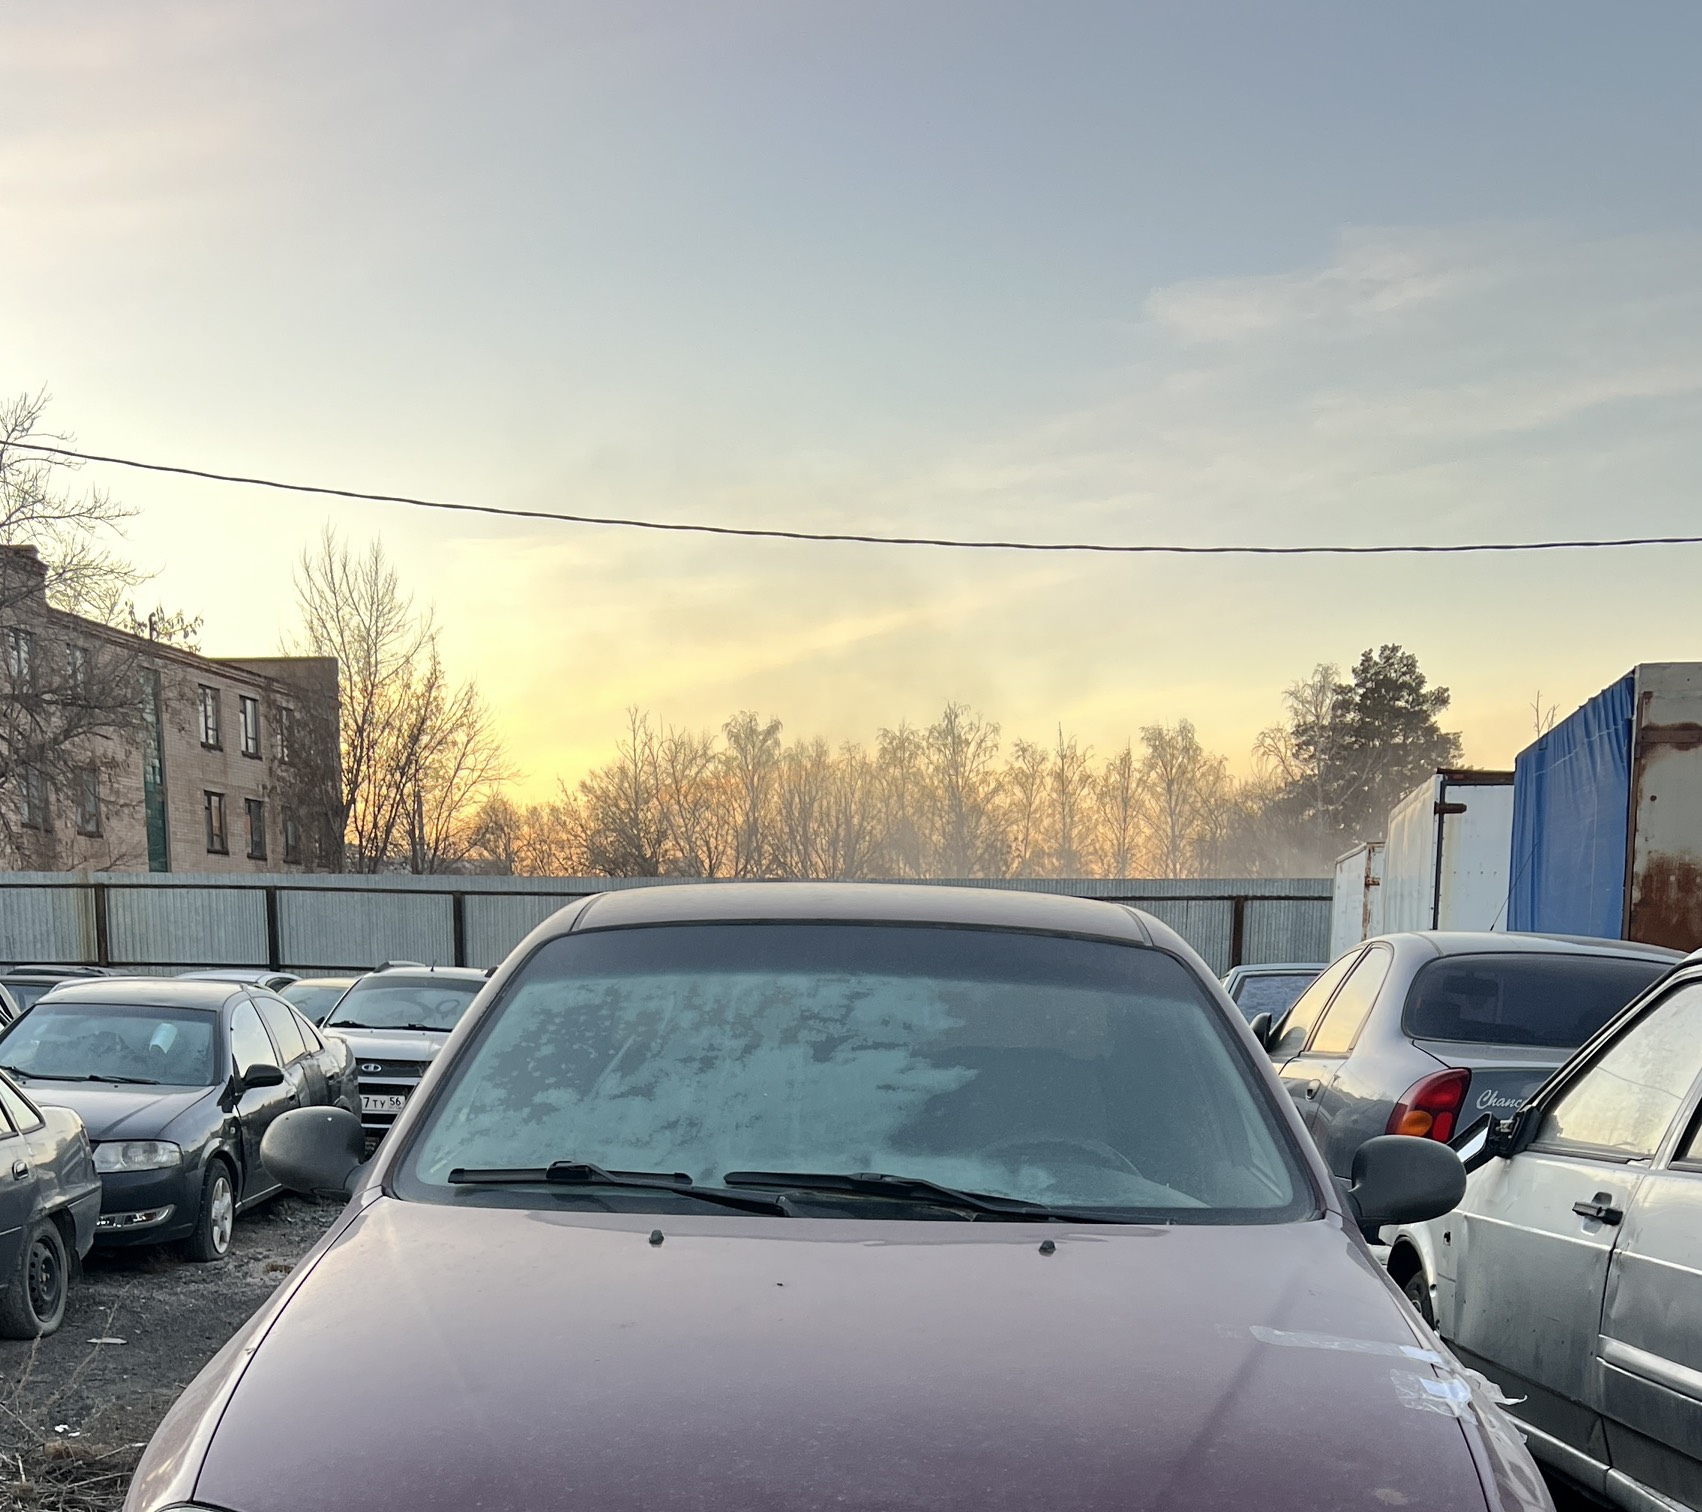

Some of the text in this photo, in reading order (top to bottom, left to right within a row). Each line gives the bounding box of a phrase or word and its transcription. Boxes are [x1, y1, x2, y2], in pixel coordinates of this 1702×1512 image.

[362, 1097, 401, 1108] 7ТУ 56
[1476, 1089, 1523, 1109] Chanc
